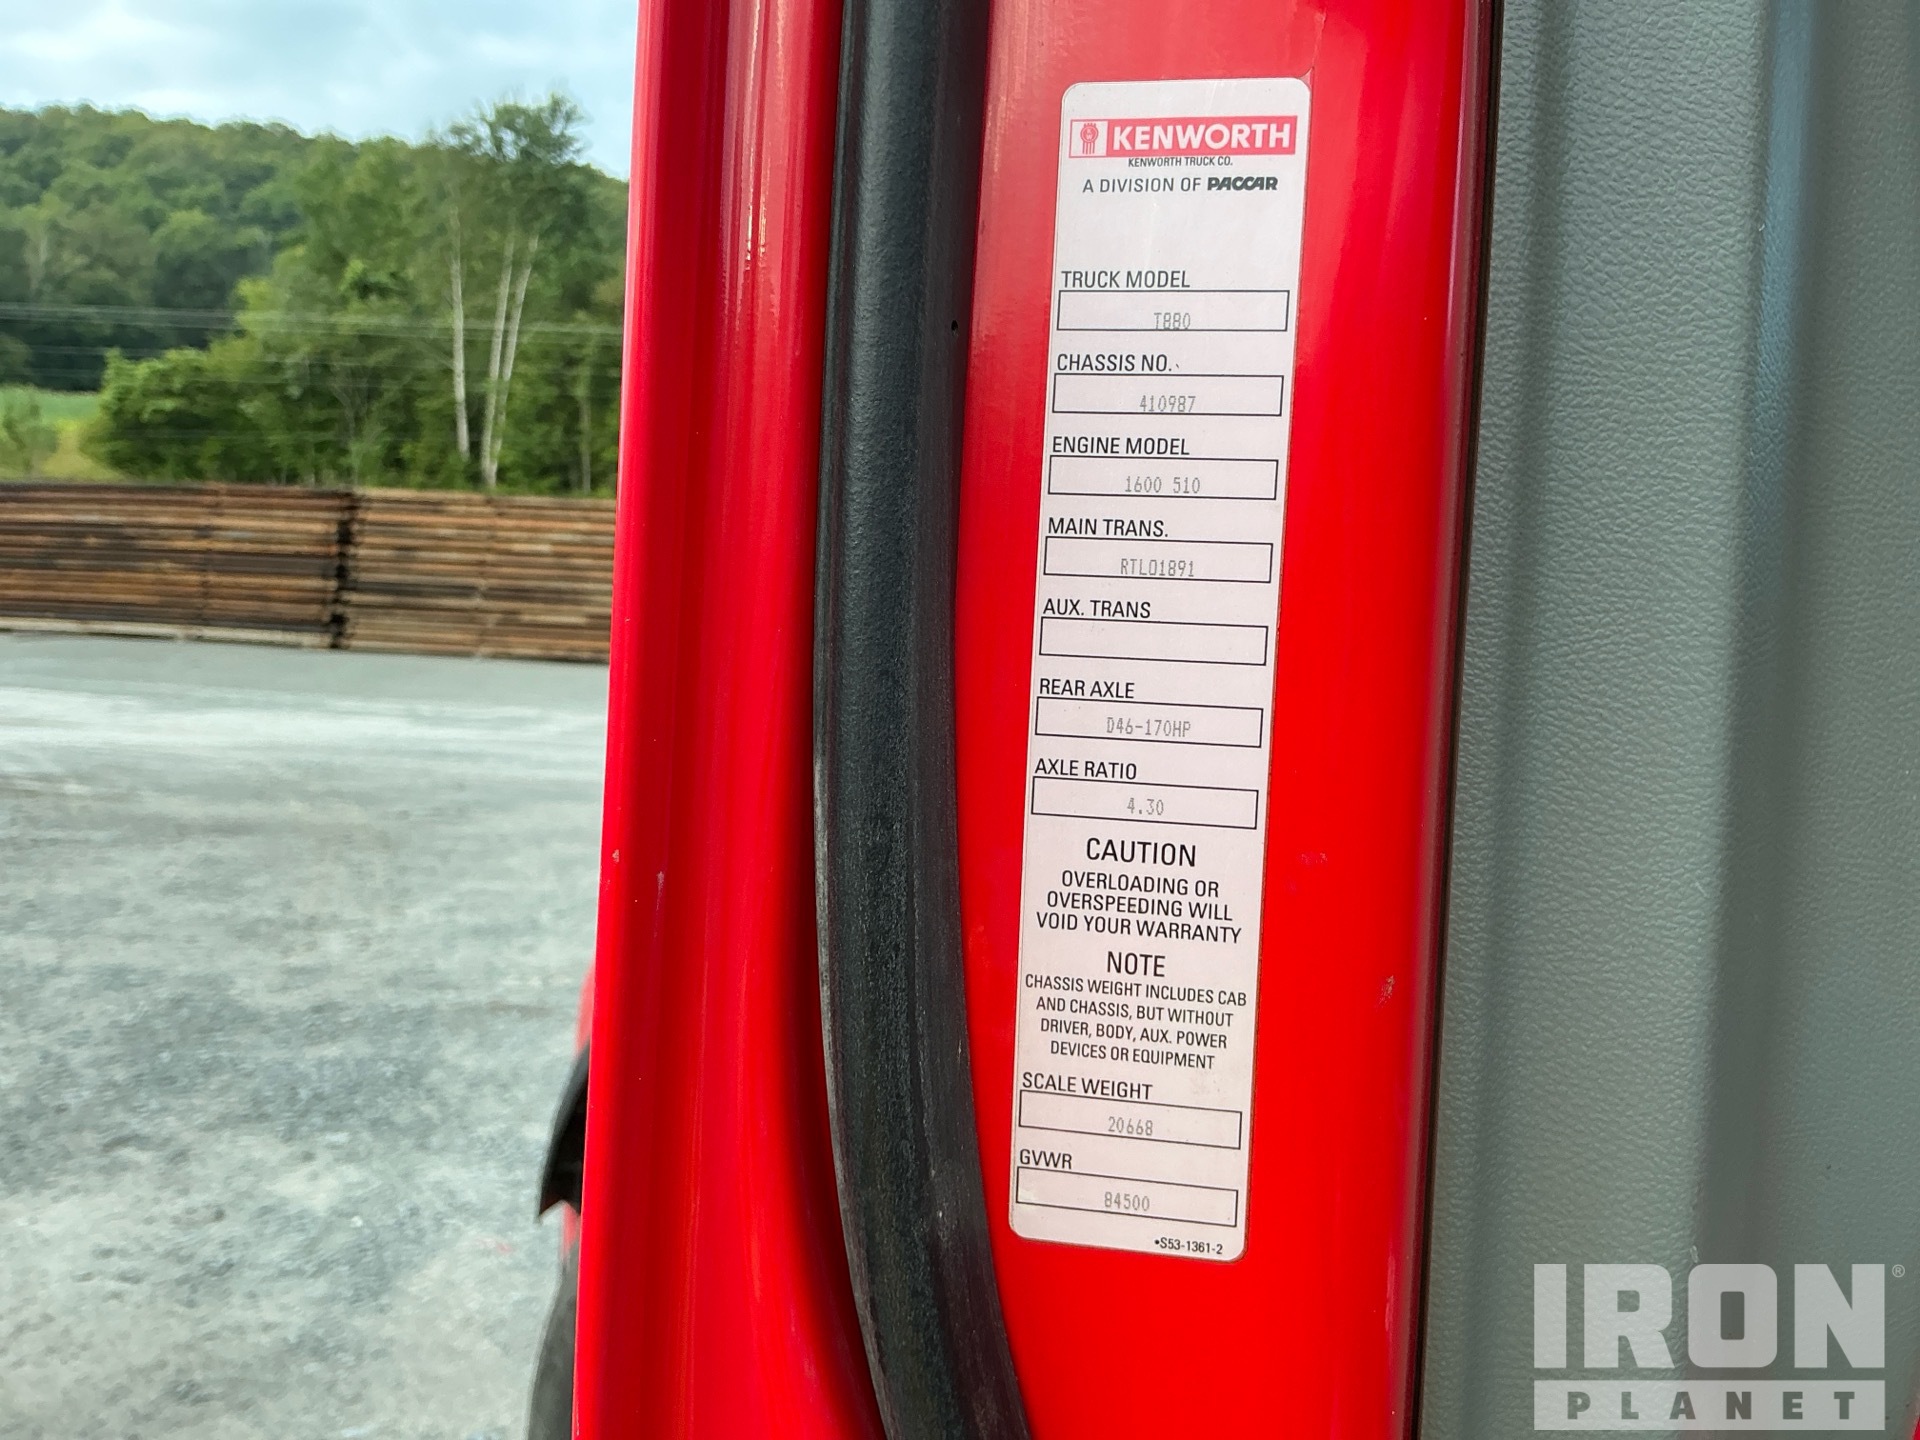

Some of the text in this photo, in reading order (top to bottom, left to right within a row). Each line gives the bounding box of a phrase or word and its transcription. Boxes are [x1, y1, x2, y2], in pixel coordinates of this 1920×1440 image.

[1113, 123, 1291, 150] KENWORTH
[1128, 156, 1232, 167] KENWORTH TRUCK CO.
[1082, 177, 1278, 193] A DIVISION OF PACCAR
[1061, 271, 1190, 287] TRUCK MODEL
[1057, 354, 1172, 371] CHASSIS NO.
[1139, 395, 1196, 412] 410987
[1053, 436, 1189, 455] ENGINE MODEL
[1125, 476, 1200, 494] 1600 510
[1048, 517, 1168, 537] MAIN TRANS.
[1043, 598, 1151, 618] AUX. TRANS
[1040, 678, 1135, 698] REAR AXLE
[1035, 758, 1137, 780] AXLE RATIO
[1127, 798, 1164, 816] 4.30
[1087, 838, 1196, 867] CAUTION
[1062, 870, 1219, 897] OVERLOADING OR
[1047, 891, 1232, 921] OVERSPEEDING WILL
[1036, 912, 1242, 943] VOID YOUR WARRANTY
[1107, 951, 1165, 977] NOTE
[1025, 974, 1247, 1006] CHASSIS WEIGHT INCLUDES CAB
[1036, 997, 1233, 1027] AND CHASSIS, BUT WITHOUT
[1041, 1018, 1227, 1049] DRIVER, BODY, AUX. POWER
[1051, 1041, 1215, 1069] DEVICES OR EQUIPMENT
[1022, 1072, 1153, 1100] SCALE WEIGHT
[1108, 1116, 1153, 1136] 20668
[1020, 1149, 1072, 1169] GVWR
[1104, 1192, 1150, 1212] 84500
